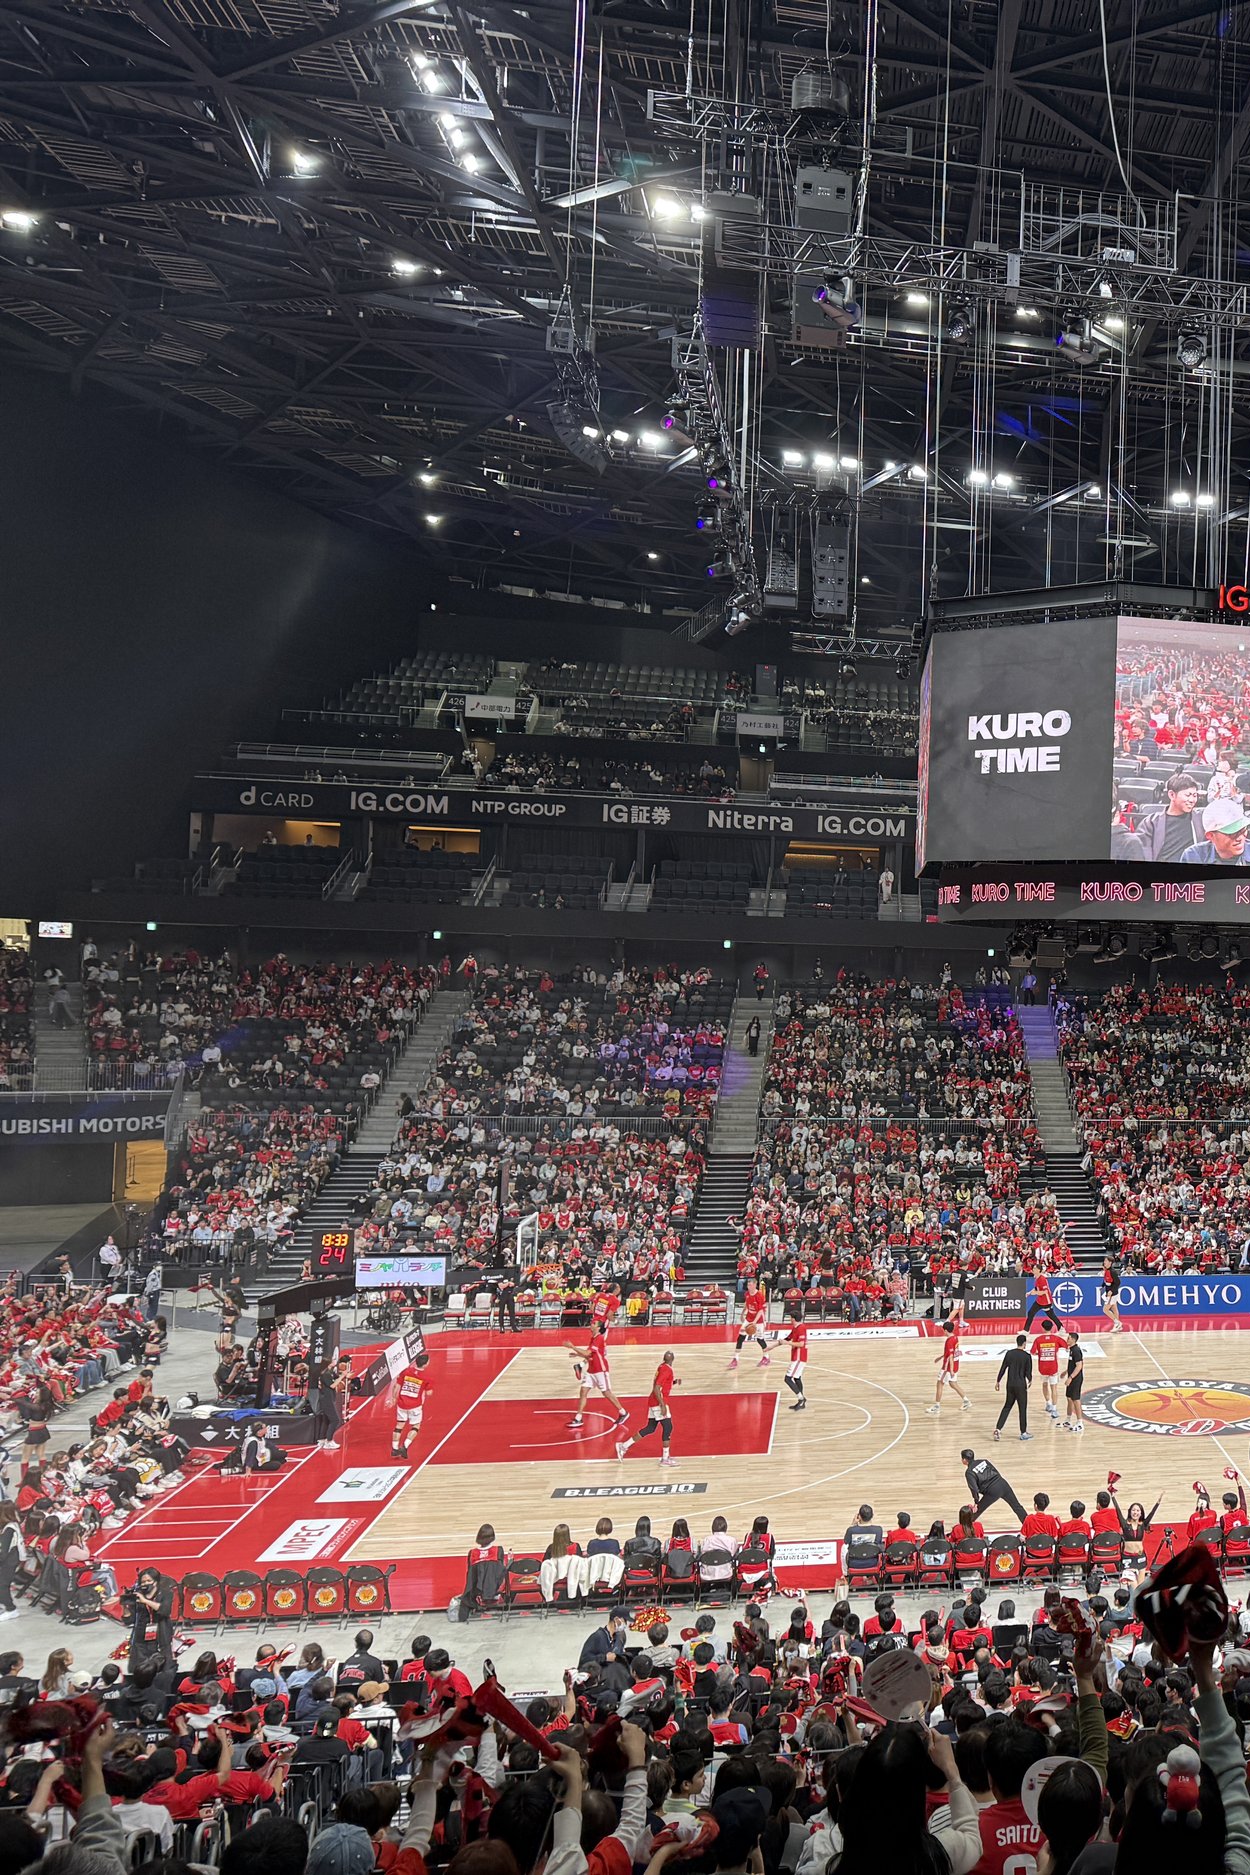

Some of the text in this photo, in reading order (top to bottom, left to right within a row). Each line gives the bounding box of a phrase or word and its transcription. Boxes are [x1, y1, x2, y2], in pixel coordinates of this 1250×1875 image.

[1219, 585, 1249, 611] IG
[448, 697, 465, 706] 426
[516, 701, 531, 710] 425
[720, 715, 736, 723] 425
[968, 709, 1072, 741] KURO
[974, 746, 1061, 774] TIME
[260, 791, 314, 808] CARD
[350, 791, 448, 814] IG.COM
[471, 800, 566, 817] NTP GROUP
[602, 804, 671, 826] IG証券
[708, 810, 793, 832] Niterra
[817, 815, 906, 837] IG.COM
[971, 882, 1055, 902] KURO TIME
[1080, 882, 1205, 903] KURO TIME
[79, 1114, 166, 1133] MOTORS
[319, 1247, 346, 1265] 24
[982, 1286, 1008, 1298] CLUB
[968, 1299, 1021, 1311] PARTNERS
[1112, 1380, 1236, 1393] NAGOYA
[564, 1483, 696, 1497] B.LEAGUE 10
[276, 1524, 331, 1555] MPEC
[996, 1824, 1040, 1847] SAITO
